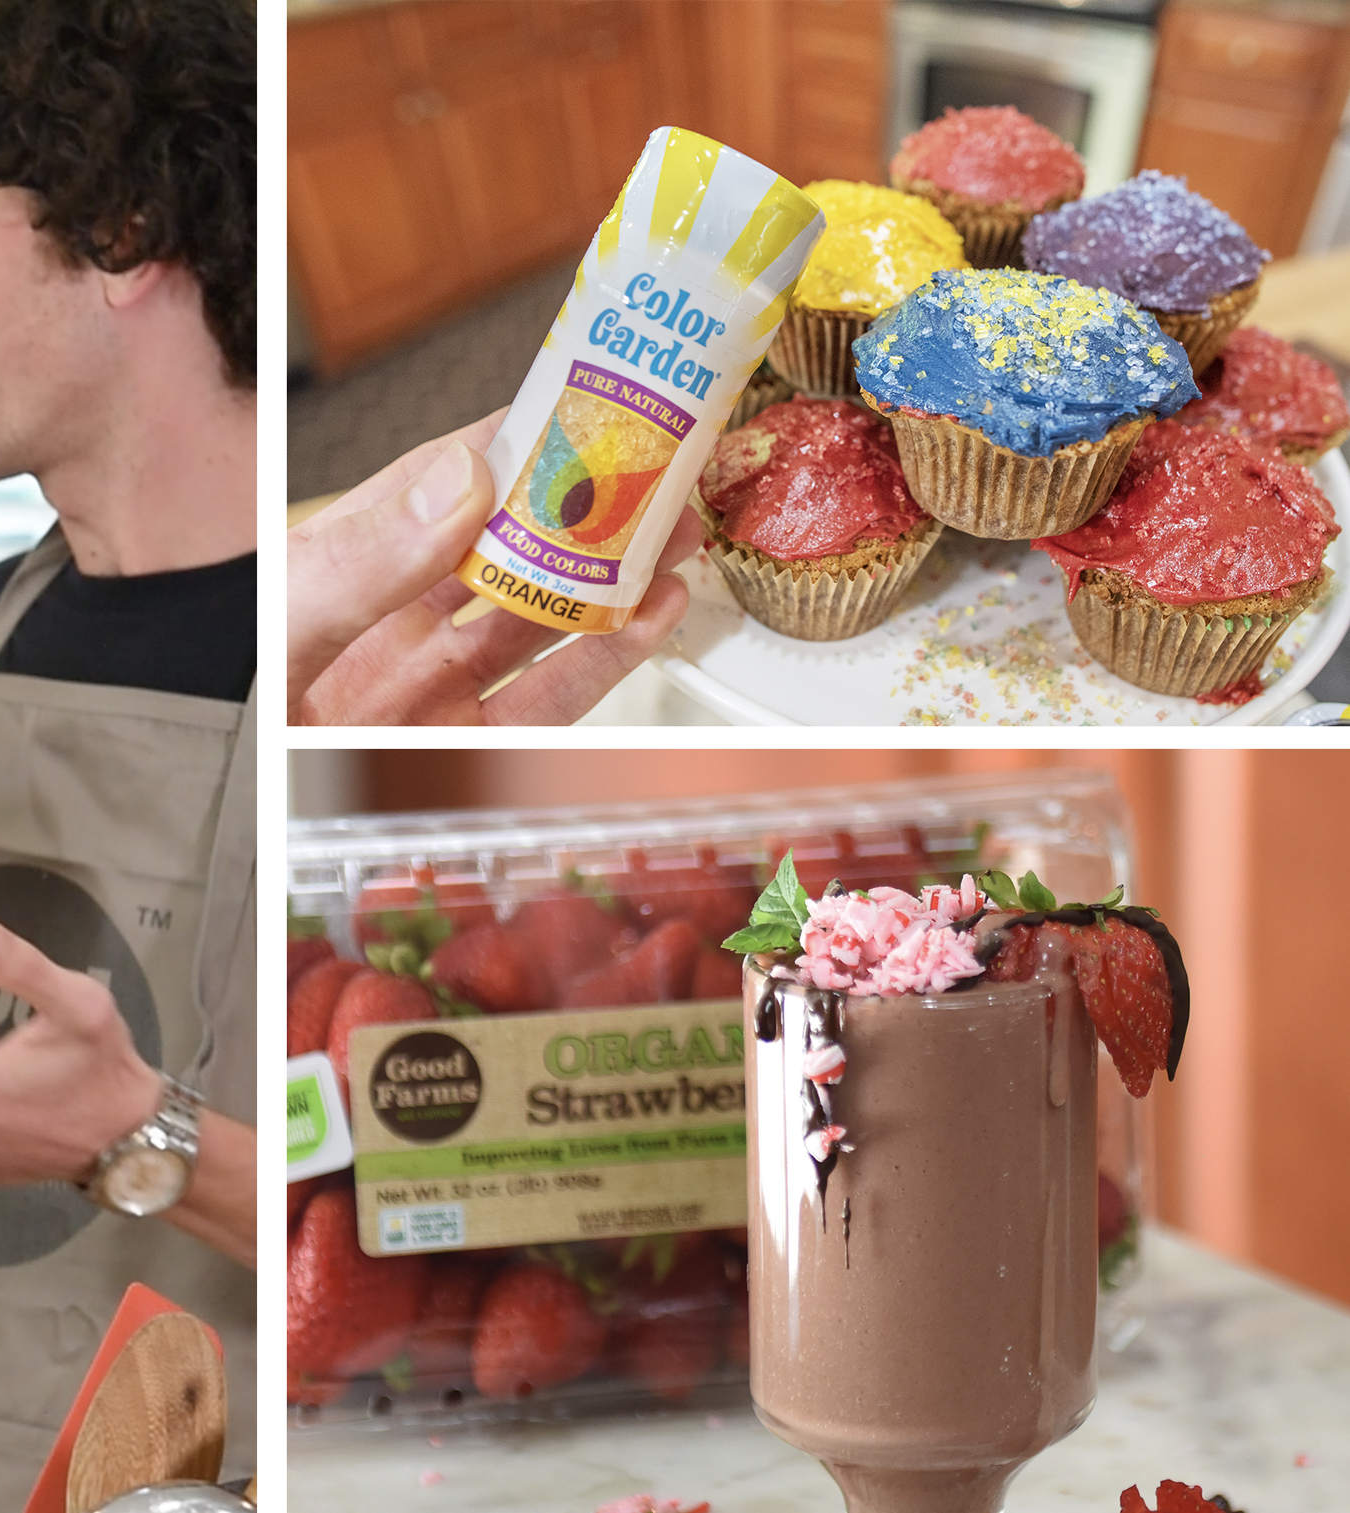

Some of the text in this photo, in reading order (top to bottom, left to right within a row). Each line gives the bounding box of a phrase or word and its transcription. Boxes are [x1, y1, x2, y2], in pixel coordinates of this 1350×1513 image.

[624, 272, 725, 347] Color
[588, 308, 715, 402] Garden
[572, 367, 688, 435] PURE NATURAL
[497, 520, 610, 580] FOOD COLORS
[481, 563, 588, 622] ORANGE
[506, 556, 576, 595] Net Wt 3oz
[137, 906, 173, 930] TM
[385, 1049, 469, 1083] Good
[373, 1072, 480, 1111] Farms
[376, 1186, 409, 1206] Net
